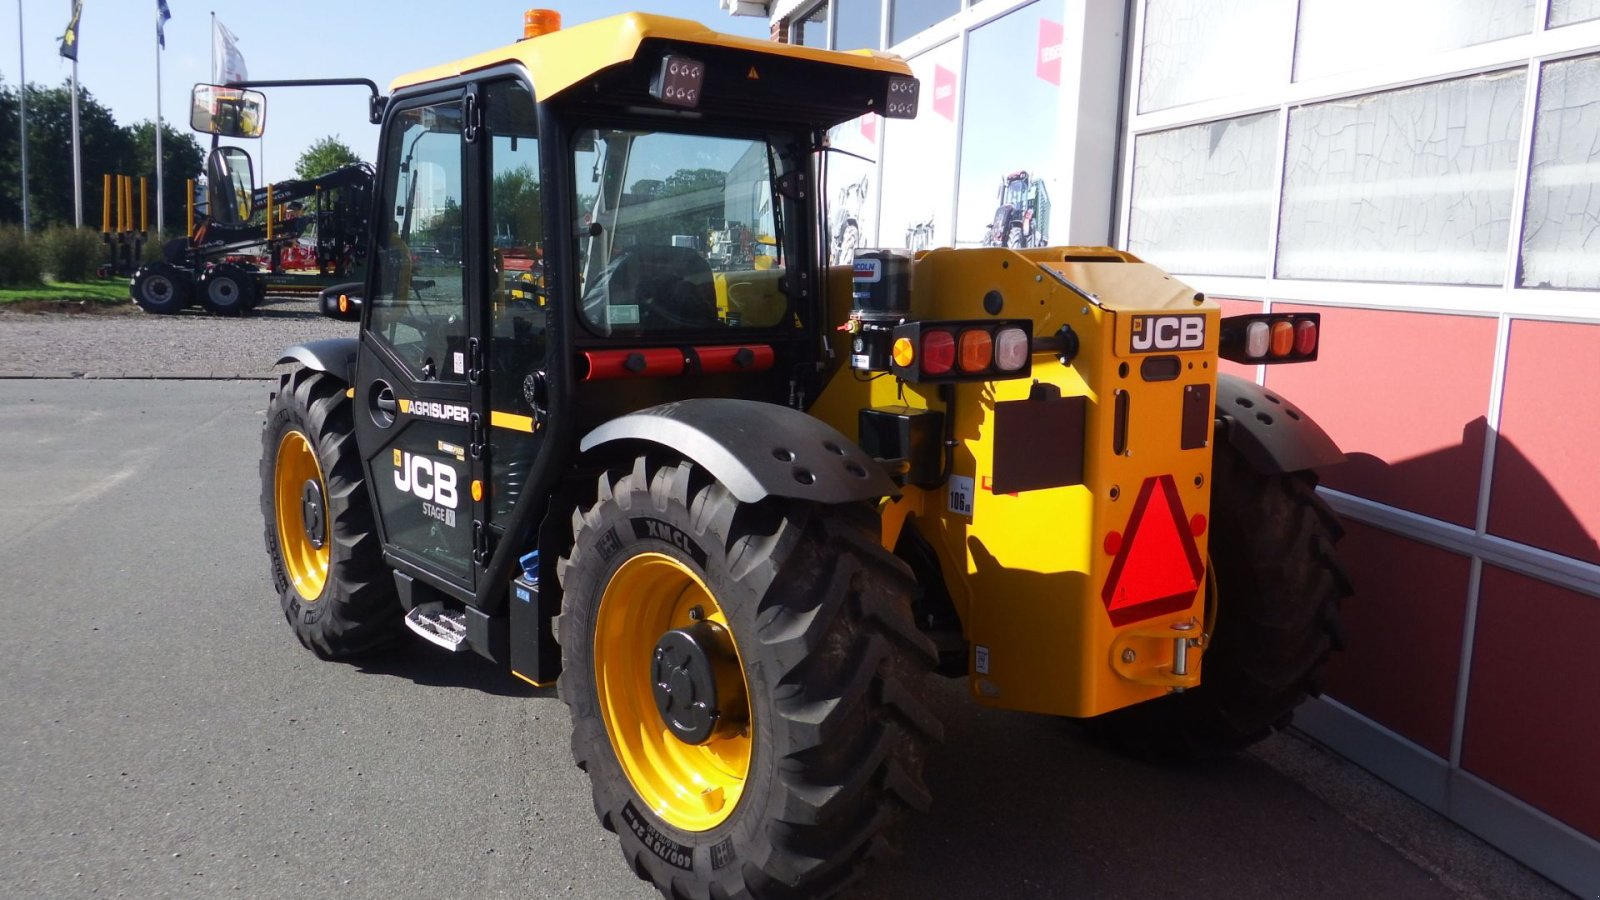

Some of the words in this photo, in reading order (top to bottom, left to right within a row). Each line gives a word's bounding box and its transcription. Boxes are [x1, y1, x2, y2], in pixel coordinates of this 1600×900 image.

[1132, 316, 1204, 350] JCB
[409, 401, 470, 422] AGRISUPER
[393, 451, 458, 509] JCB
[422, 502, 446, 521] STAGE
[950, 491, 965, 511] 106
[645, 520, 692, 555] XMCL
